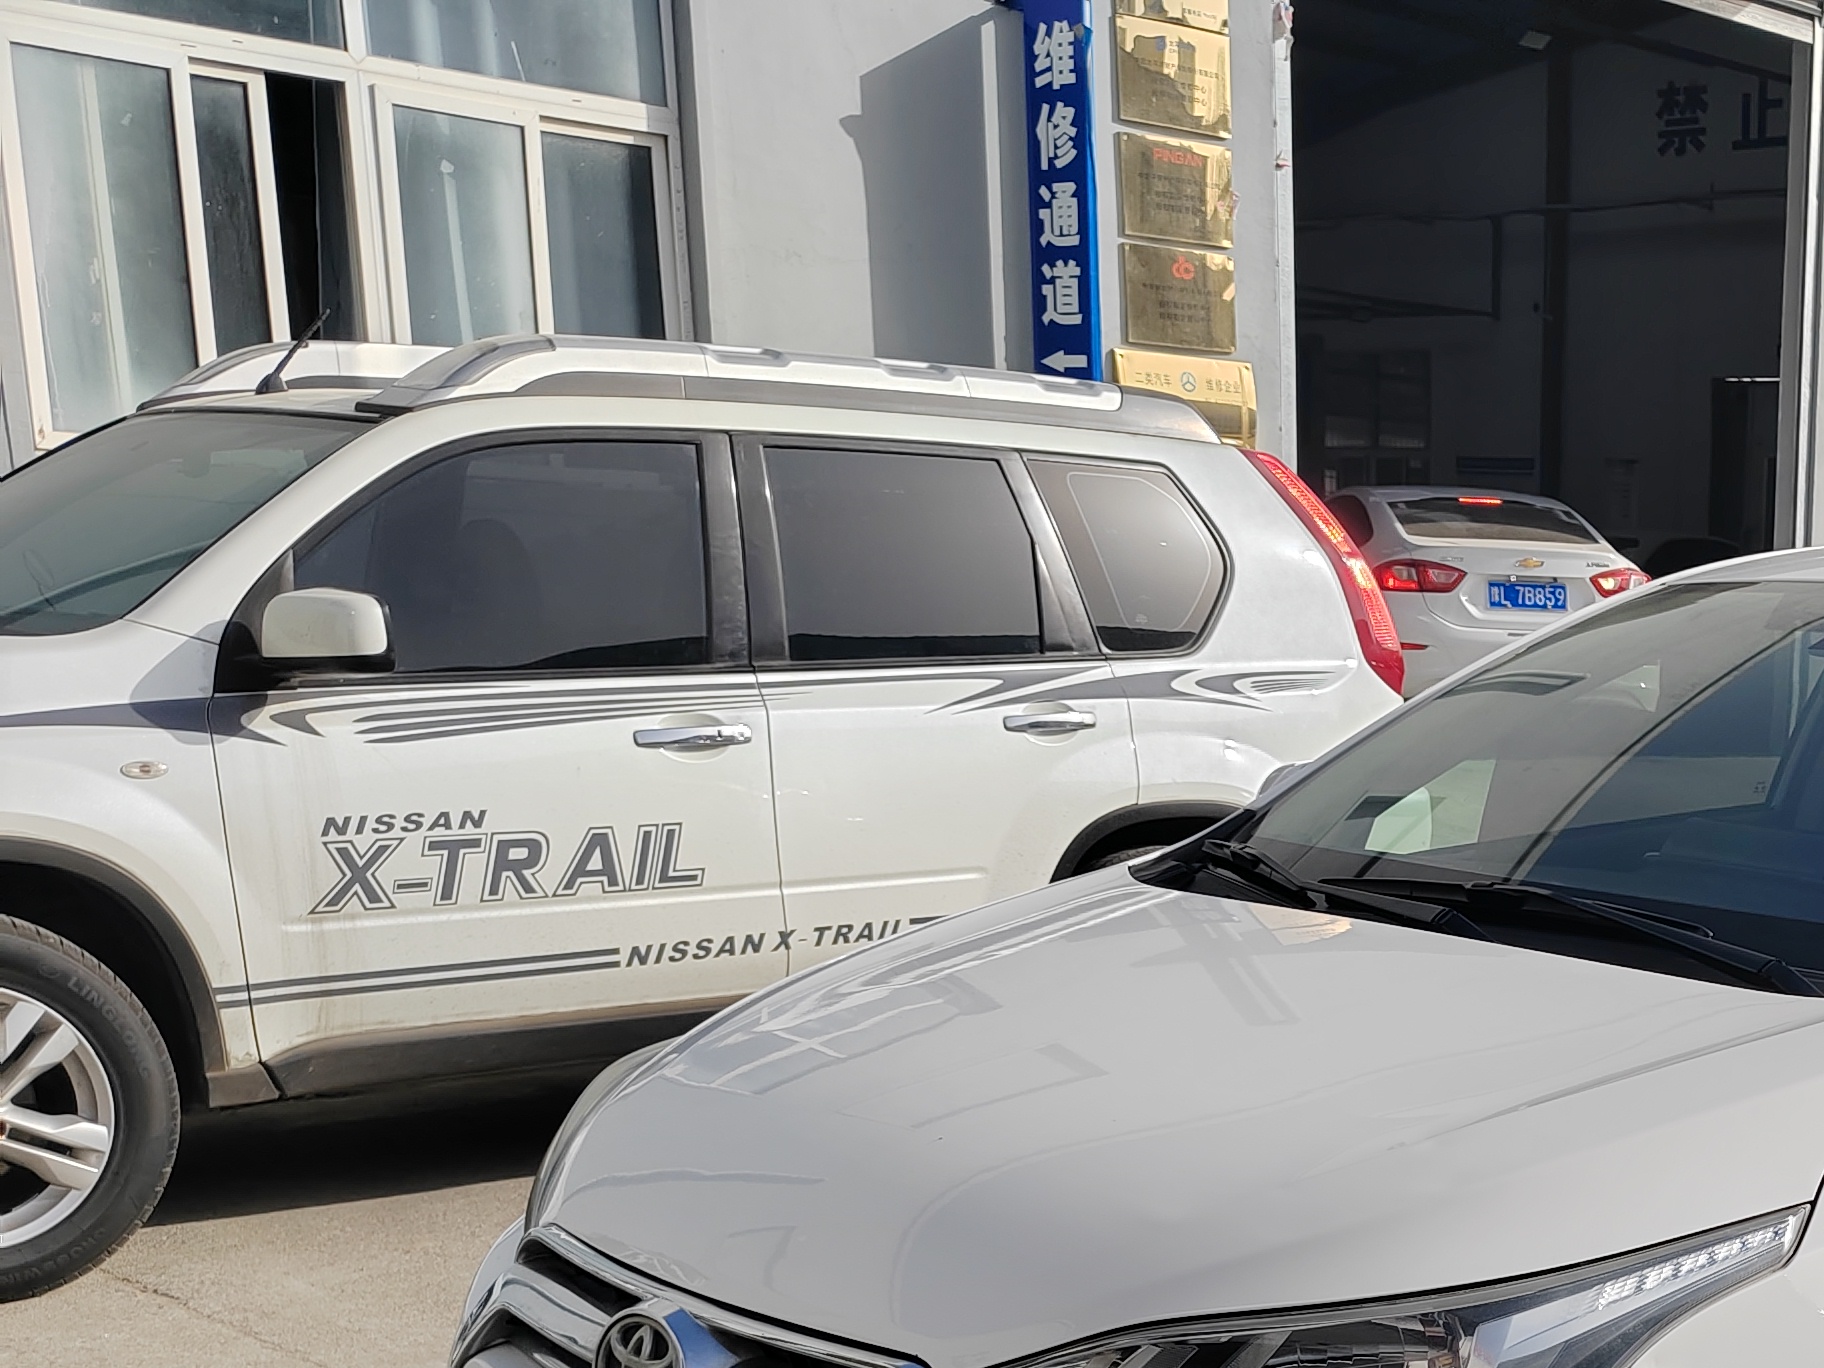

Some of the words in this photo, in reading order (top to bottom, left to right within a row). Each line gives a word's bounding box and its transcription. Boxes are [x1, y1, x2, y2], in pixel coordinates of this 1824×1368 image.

[1655, 81, 1788, 156] 禁止
[1033, 20, 1083, 326] 维修通道
[1135, 371, 1172, 387] 二类汽车
[321, 810, 487, 837] NISSAN
[307, 822, 705, 915] X-TRAIL
[625, 933, 765, 967] NISSAN
